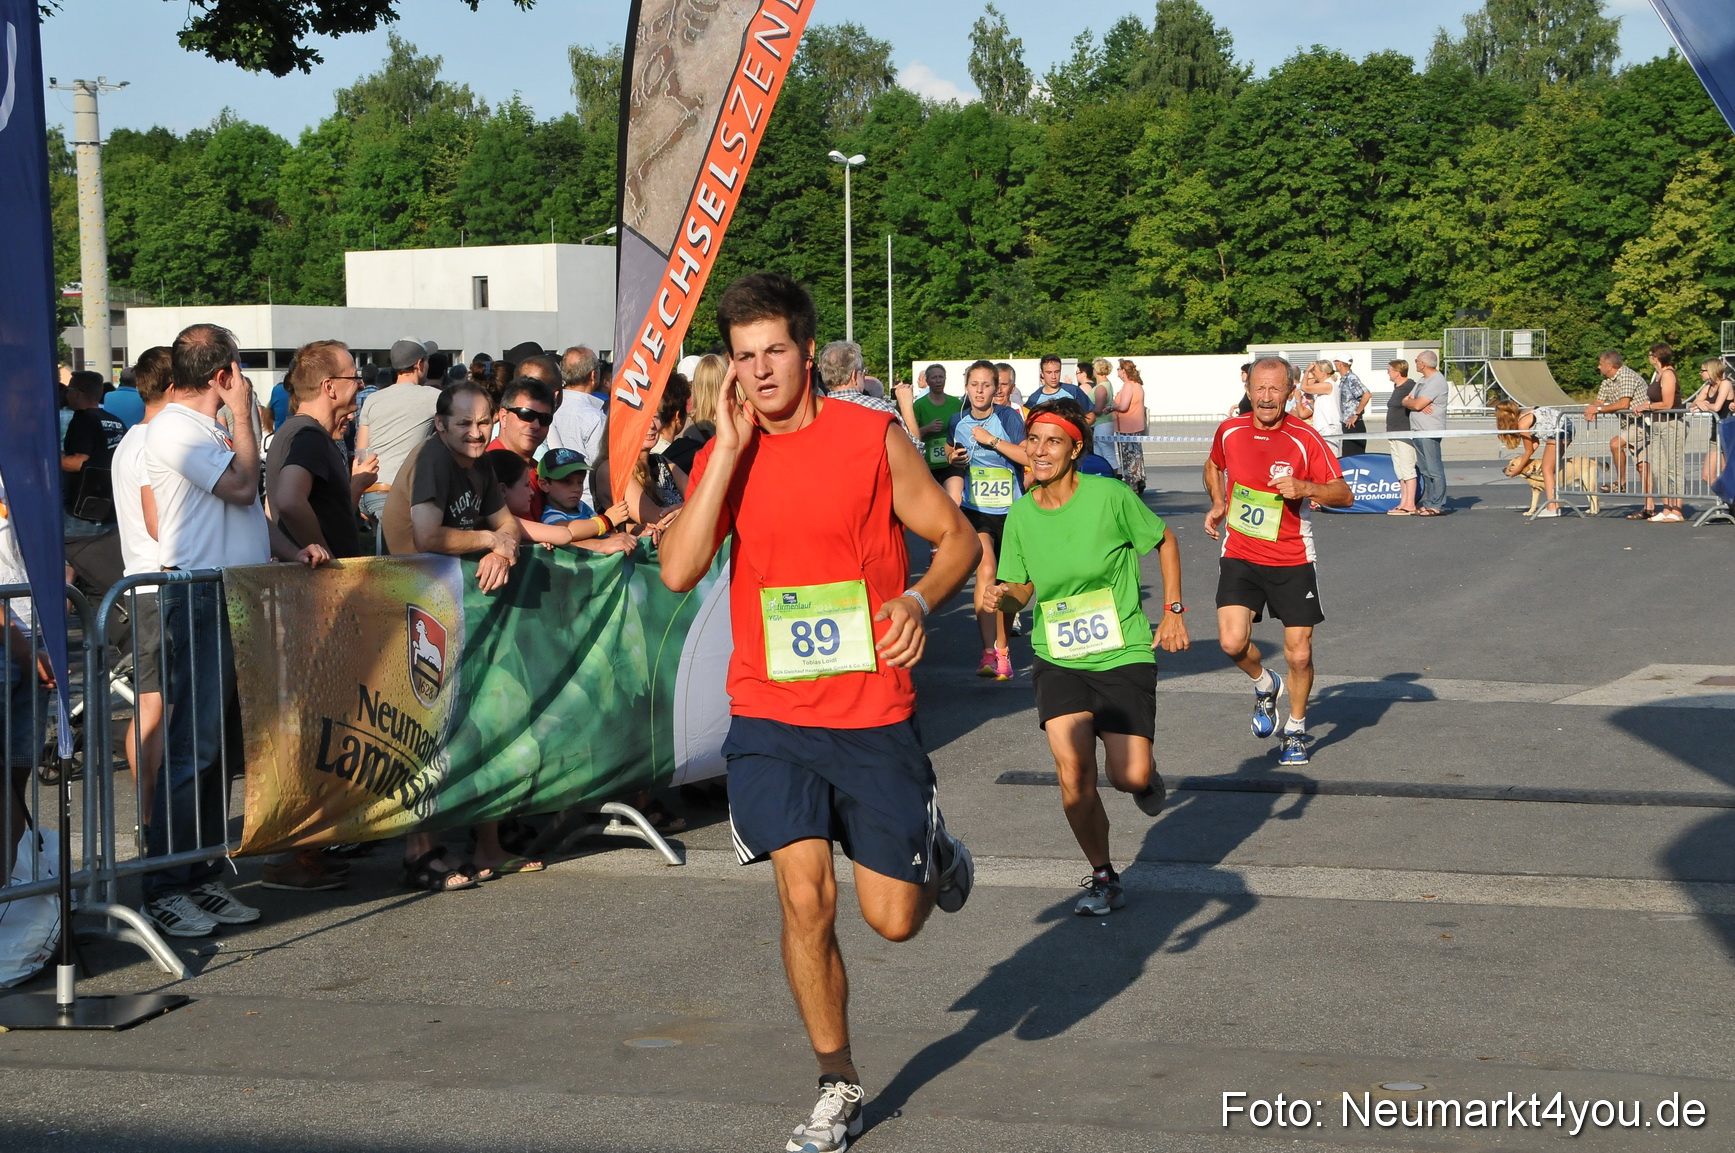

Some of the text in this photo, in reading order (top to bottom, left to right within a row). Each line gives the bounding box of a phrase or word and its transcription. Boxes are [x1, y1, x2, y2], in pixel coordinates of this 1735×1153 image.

[971, 480, 1011, 497] 1245
[1346, 478, 1402, 494] ische
[1354, 493, 1402, 501] UTOMOBIL
[1239, 503, 1265, 526] 20
[777, 602, 812, 610] firmenlauf
[790, 617, 841, 659] 89
[1057, 613, 1109, 648] 566
[416, 677, 435, 700] 1628
